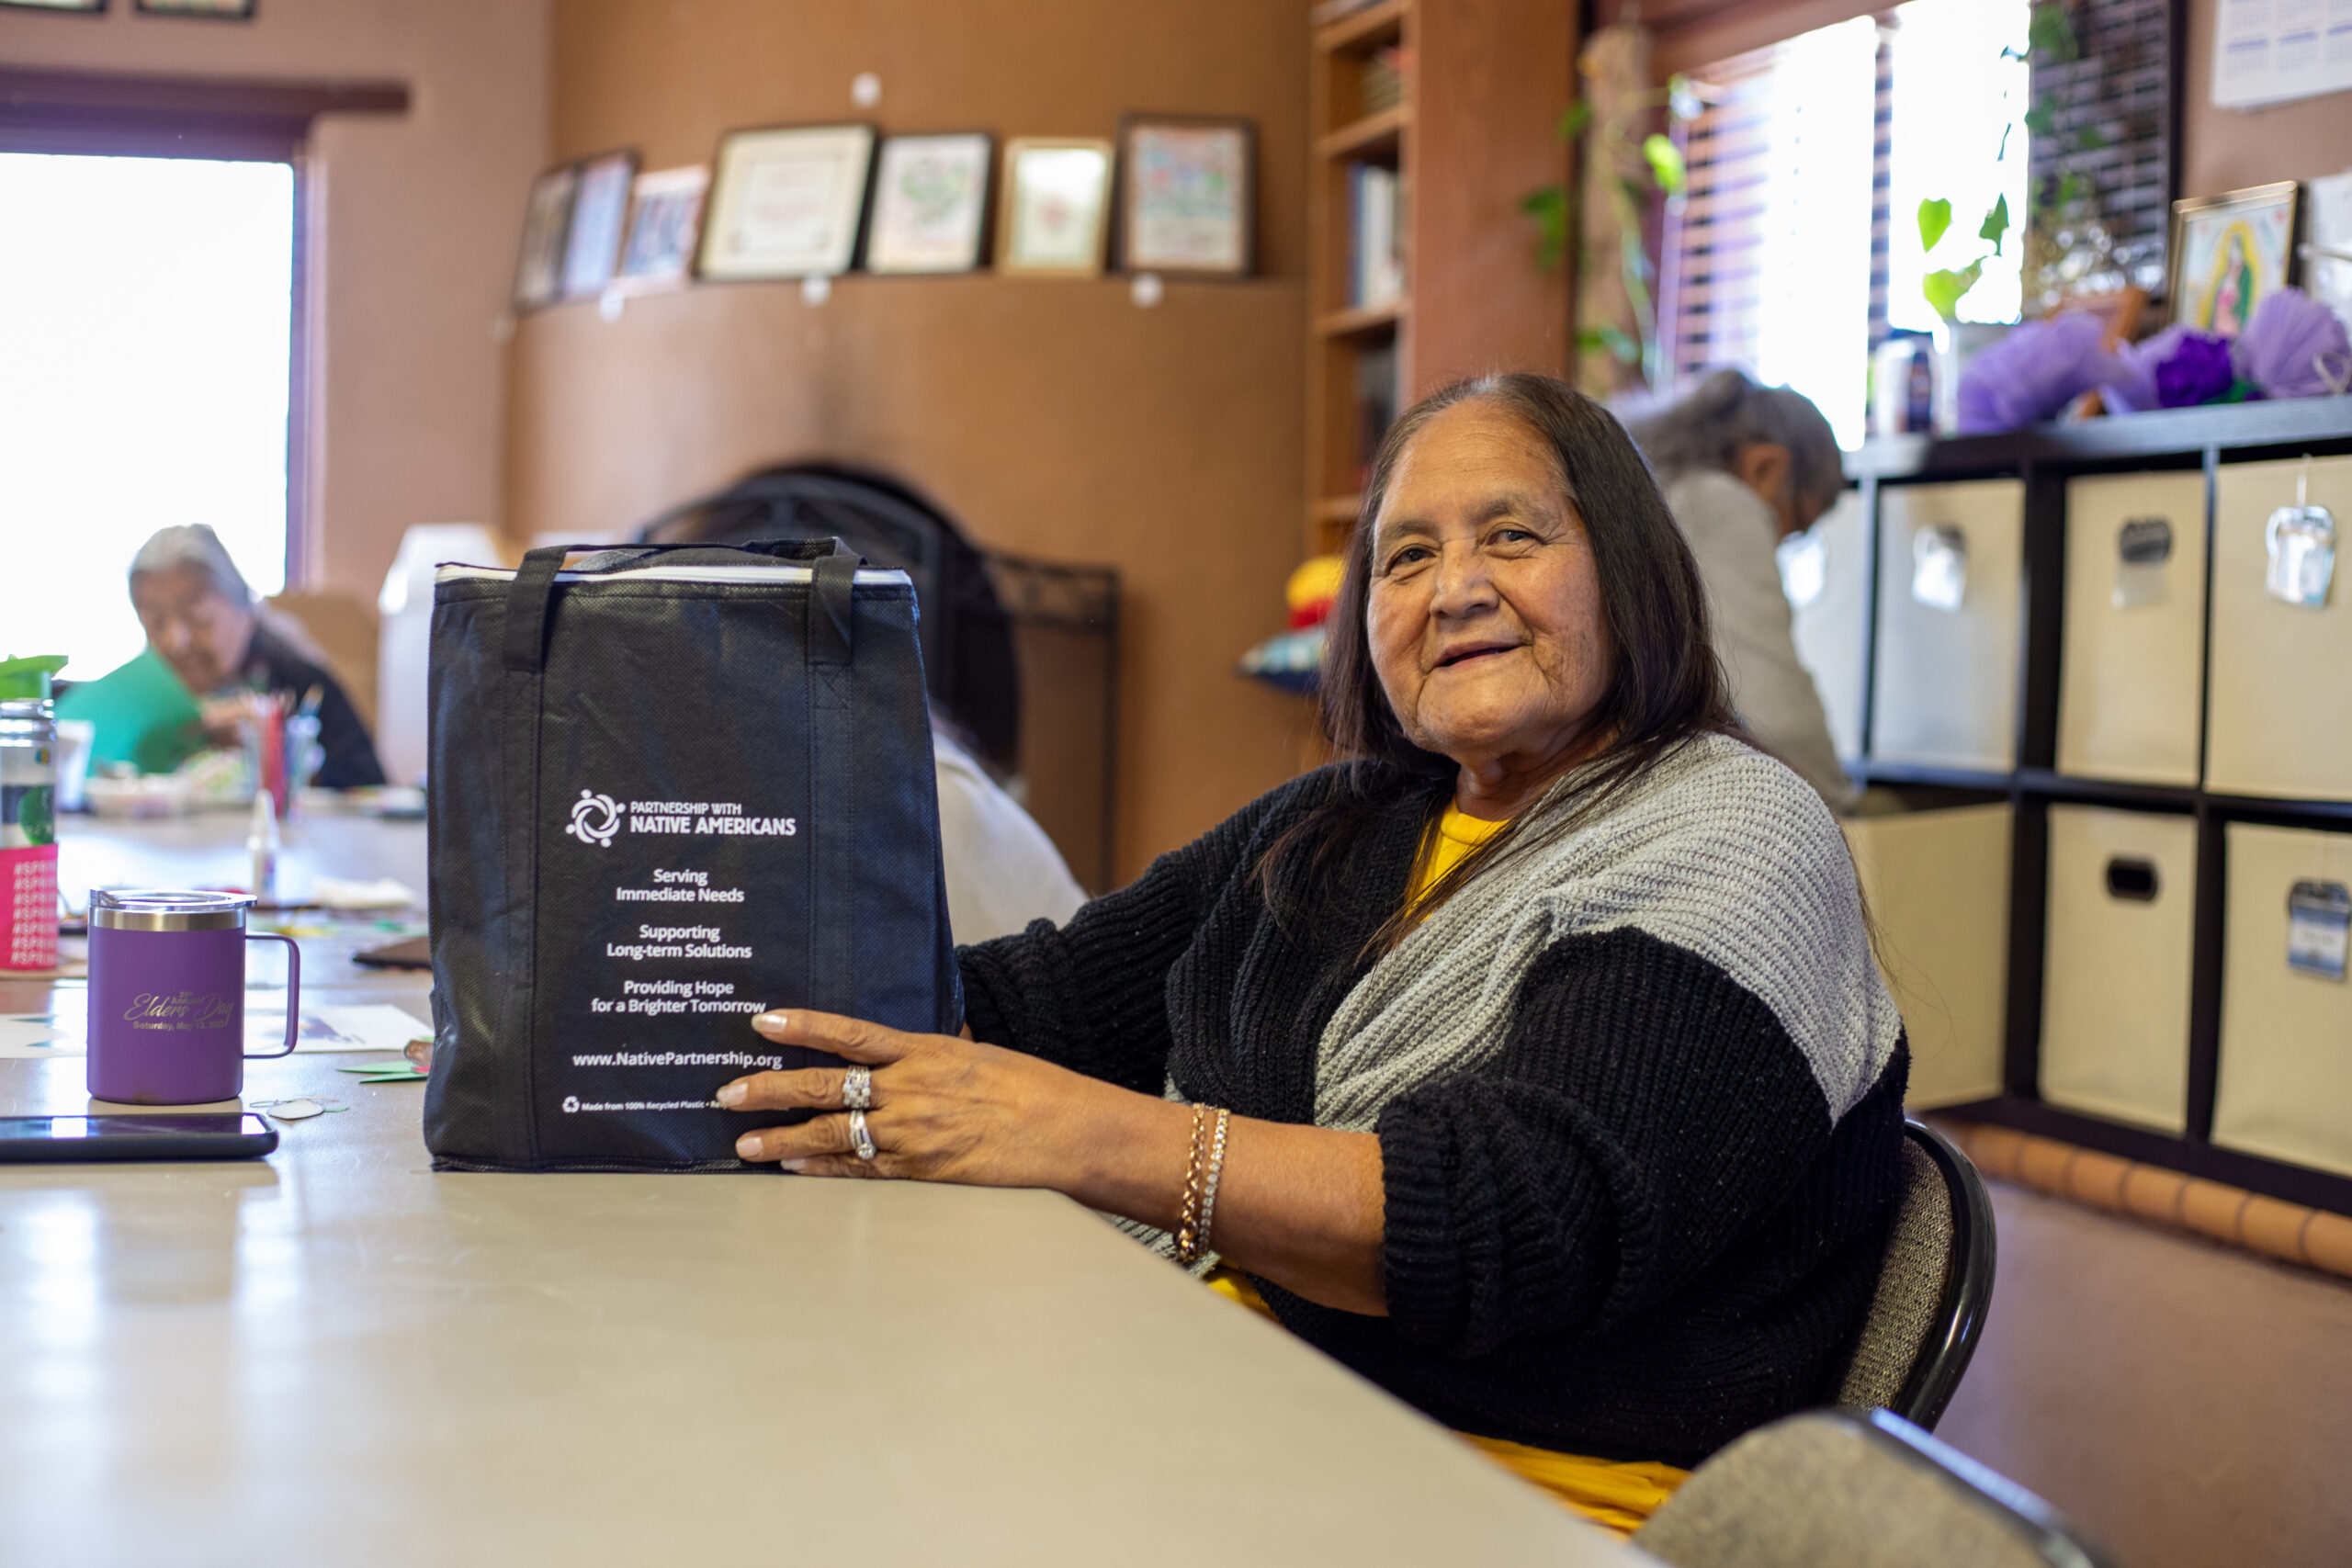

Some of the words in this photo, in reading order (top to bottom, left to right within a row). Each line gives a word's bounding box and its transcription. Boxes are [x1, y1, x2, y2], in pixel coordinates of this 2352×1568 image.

[630, 801, 709, 814] PARTNERSHIP
[711, 803, 741, 815] WITH
[630, 816, 691, 833] NATIVE
[695, 817, 796, 836] AMERICANS
[654, 869, 707, 886] Serving
[616, 887, 695, 901] Immediate
[698, 888, 744, 902] Needs
[639, 925, 720, 942] Supporting
[607, 943, 683, 960] Long-term
[685, 943, 752, 958] Solutions
[624, 980, 693, 998] Providing
[695, 981, 734, 998] Hope
[123, 993, 189, 1021] Elders
[193, 994, 235, 1028] Day
[592, 998, 614, 1012] for
[616, 1002, 626, 1012] a
[628, 998, 688, 1016] Brighter
[690, 999, 765, 1013] Tomorrow
[132, 1021, 175, 1031] Saturday,
[573, 1052, 782, 1070] www.NativePartnership.org
[582, 1101, 604, 1111] Made
[604, 1101, 624, 1111] from
[625, 1101, 646, 1111] 100%
[645, 1100, 681, 1111] Recycled
[680, 1100, 705, 1110] Plastic
